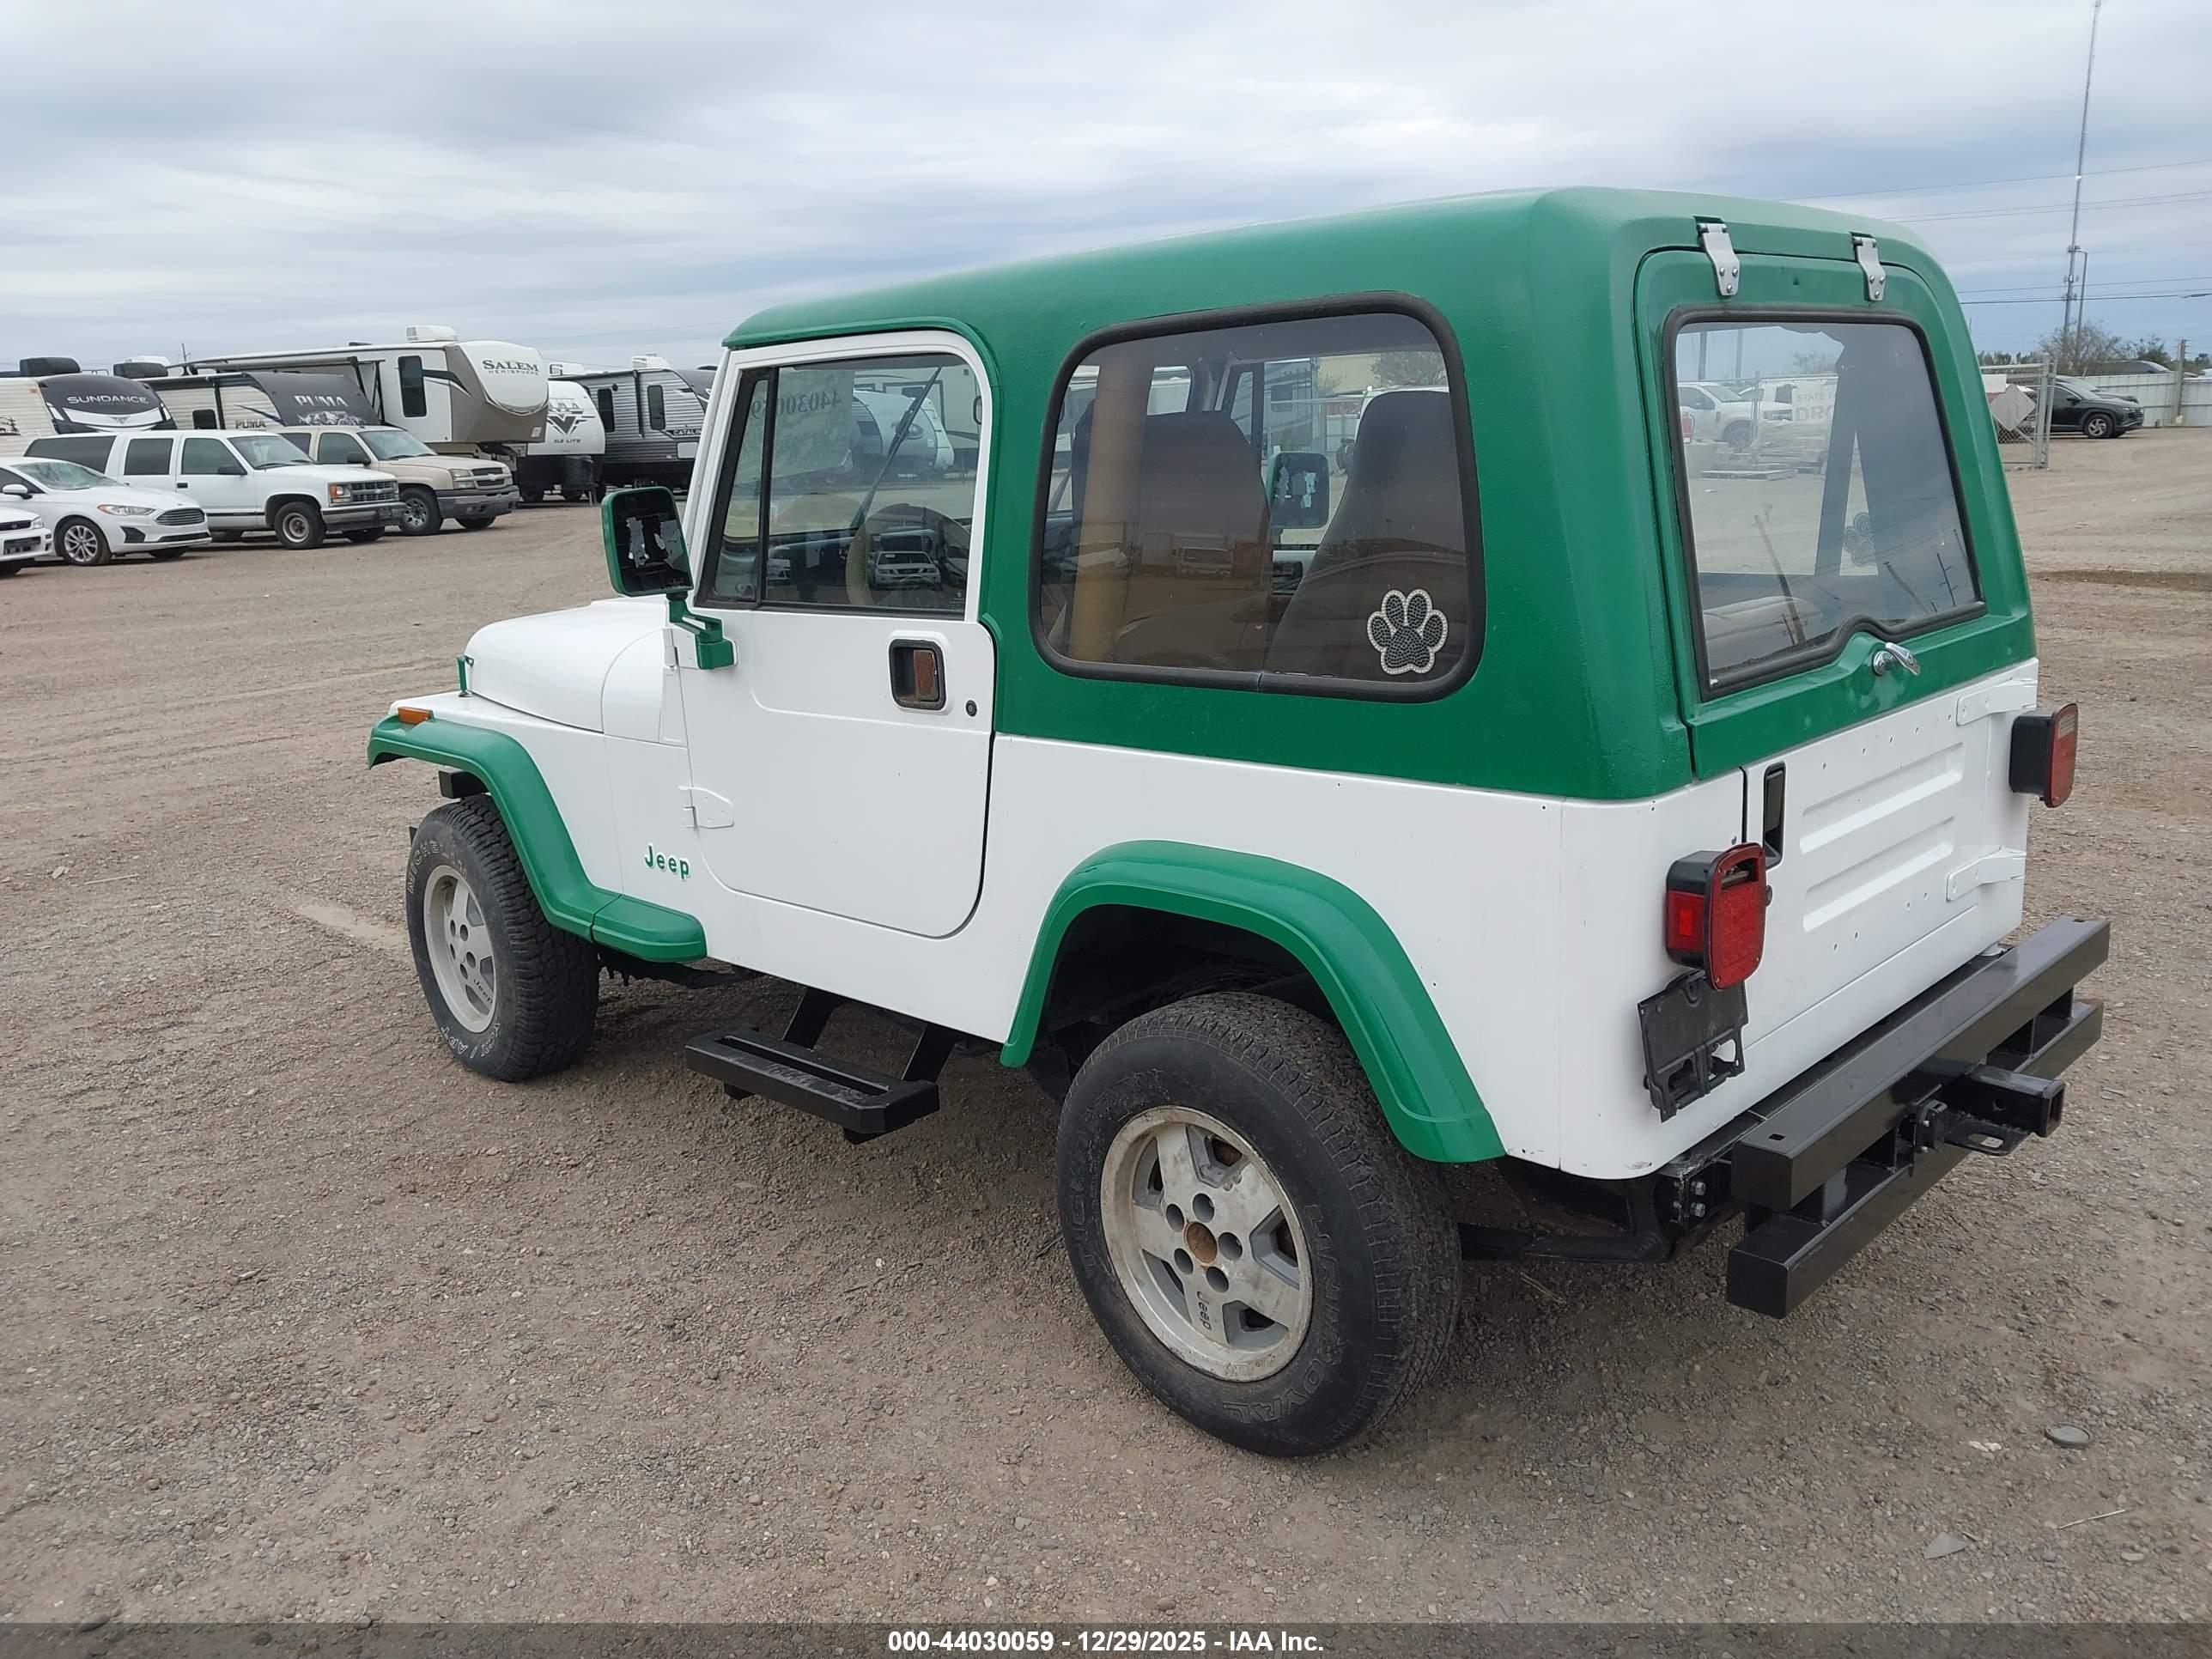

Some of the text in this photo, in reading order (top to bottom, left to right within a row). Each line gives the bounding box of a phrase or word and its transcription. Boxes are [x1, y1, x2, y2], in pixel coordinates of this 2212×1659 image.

[483, 360, 539, 372] SALEM
[67, 395, 149, 404] SUNDANCE
[294, 395, 349, 407] PUMA
[645, 844, 690, 879] Jeep
[473, 978, 494, 1005] Jeep
[1196, 1291, 1212, 1331] Jeep
